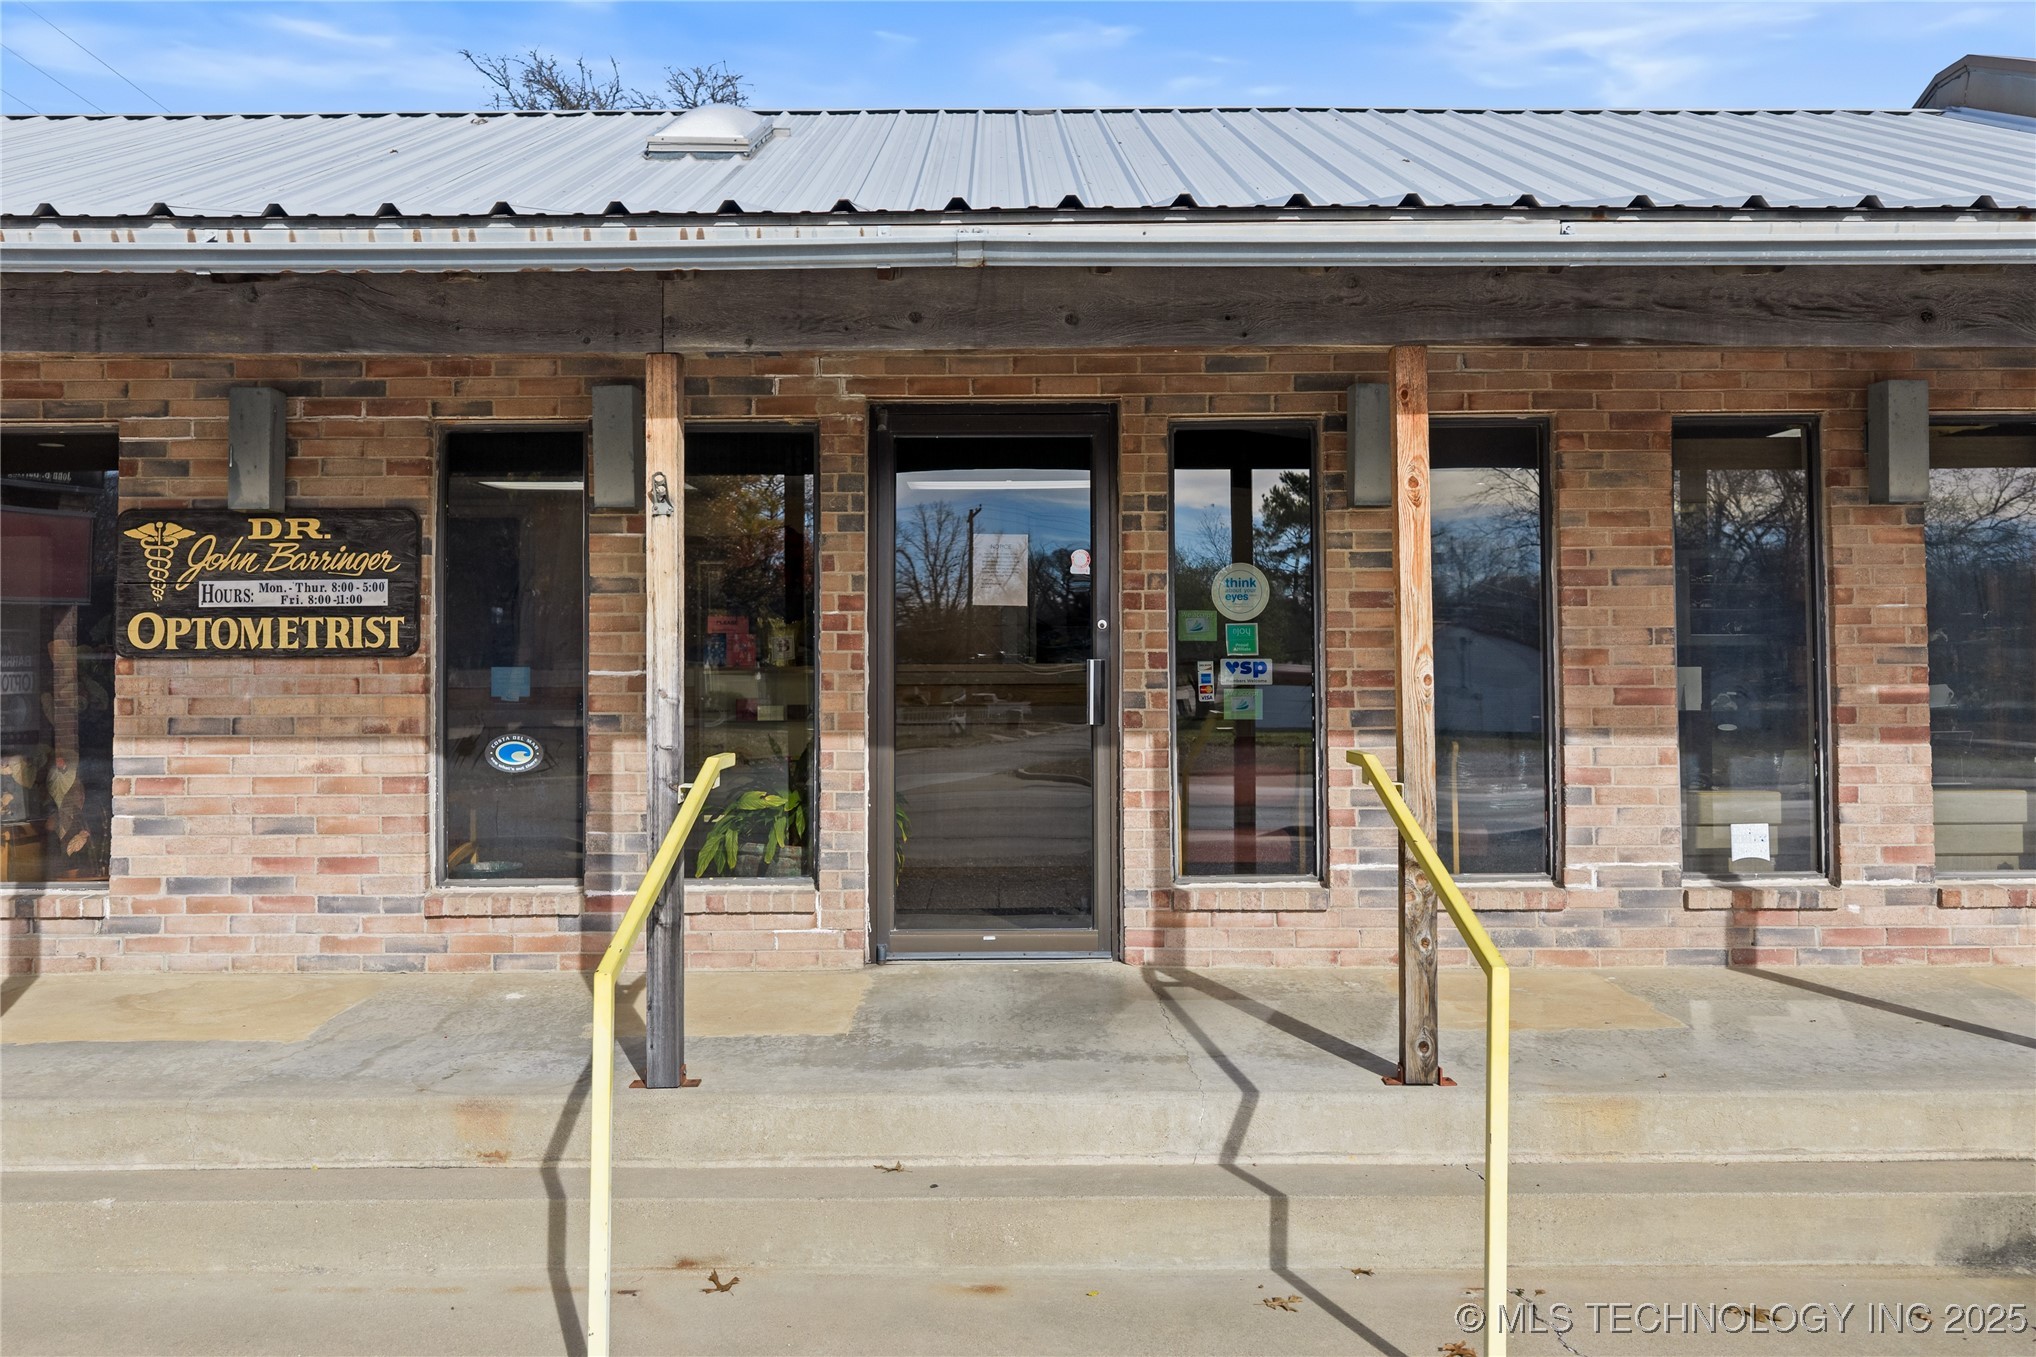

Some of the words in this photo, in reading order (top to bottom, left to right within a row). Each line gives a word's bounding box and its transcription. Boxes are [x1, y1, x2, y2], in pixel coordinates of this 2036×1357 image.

[248, 518, 331, 539] DR.
[175, 534, 261, 591] John
[263, 542, 401, 577] Barringer
[259, 582, 287, 593] Mon.
[295, 582, 327, 593] Thur.
[331, 581, 354, 593] 8:00
[362, 581, 385, 593] 5:00
[1225, 577, 1257, 588] think
[201, 583, 254, 604] HOURS:
[280, 594, 303, 605] Fri.
[308, 594, 331, 605] 8:00
[1225, 593, 1249, 602] eyes
[127, 612, 405, 650] OPTOMETRIST
[1225, 661, 1267, 678] vsp
[491, 735, 510, 749] COSTA
[526, 738, 539, 750] MAR
